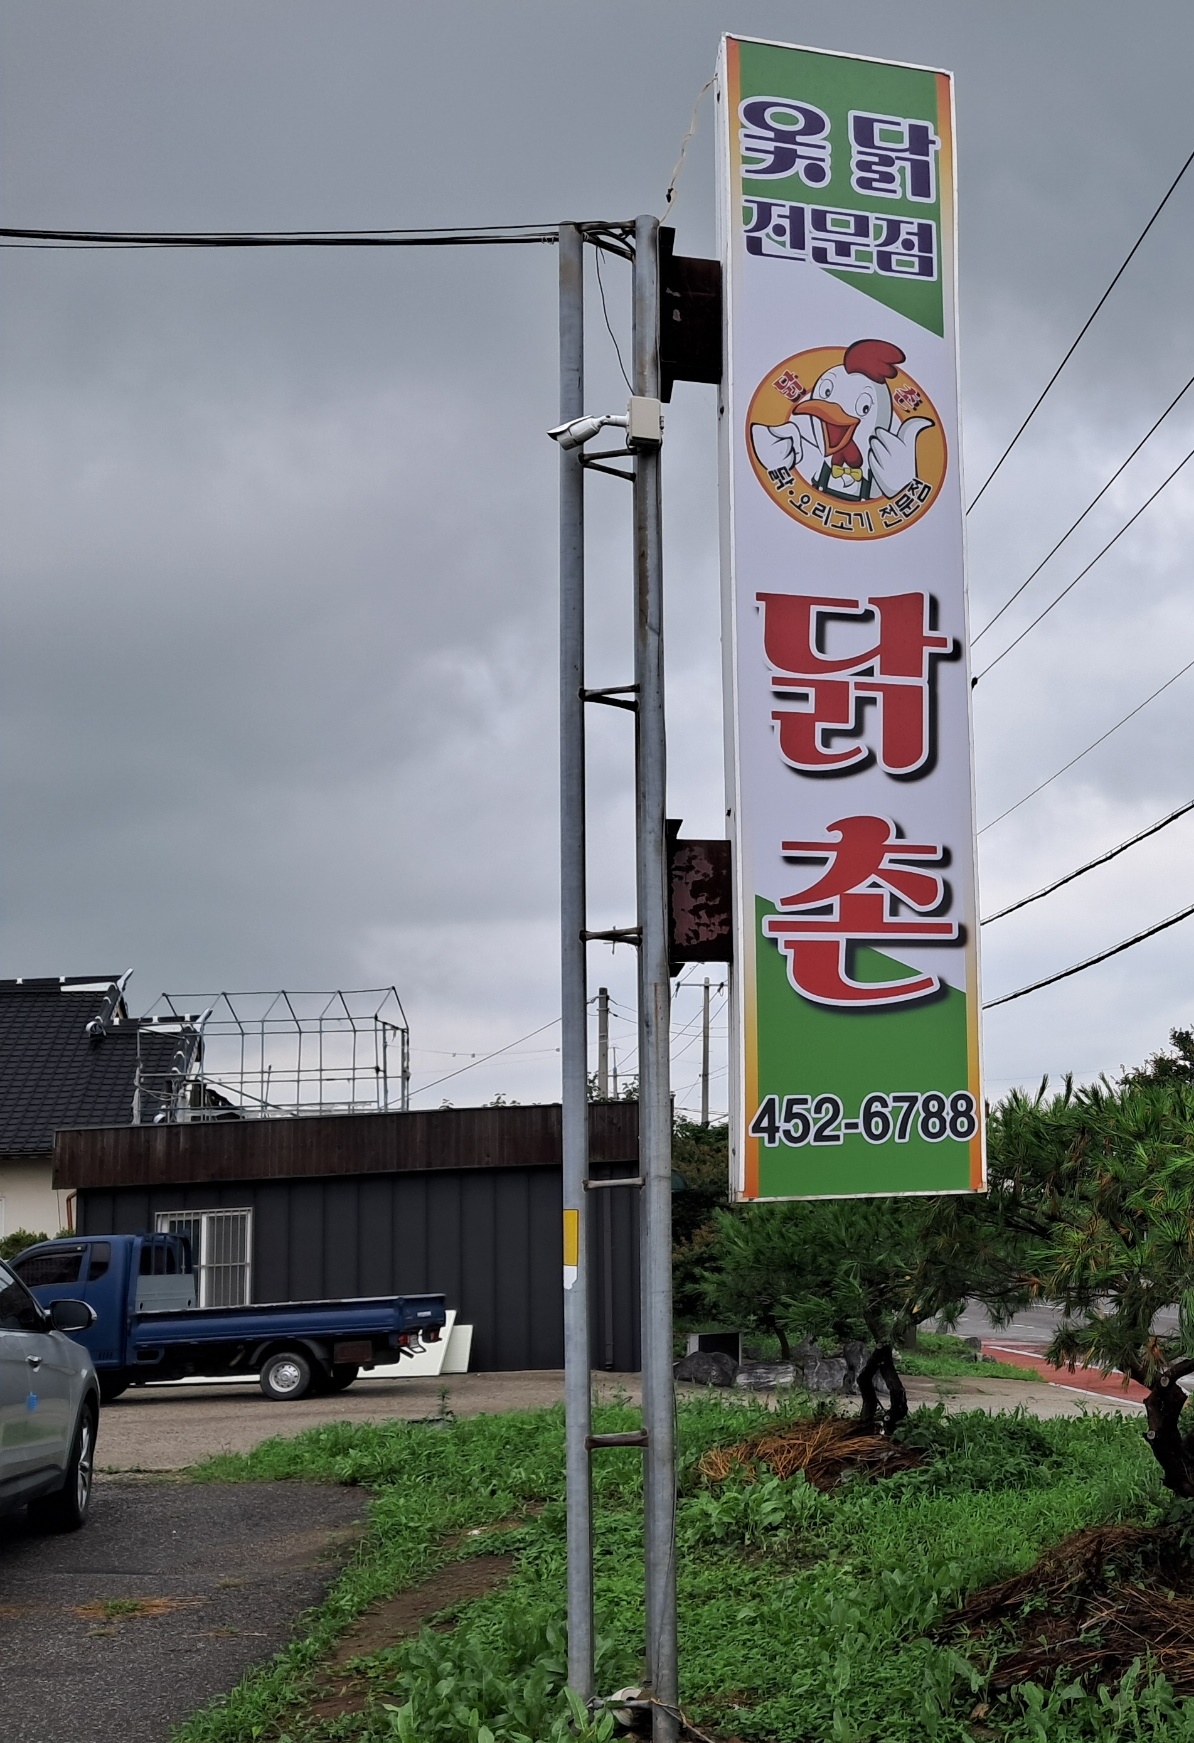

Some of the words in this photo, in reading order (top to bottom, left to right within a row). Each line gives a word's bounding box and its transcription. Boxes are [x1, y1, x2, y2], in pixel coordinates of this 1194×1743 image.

[849, 110, 940, 202] 닭
[743, 197, 937, 280] 전문점
[878, 477, 933, 530] 전문점
[750, 1091, 978, 1147] 452-6788
